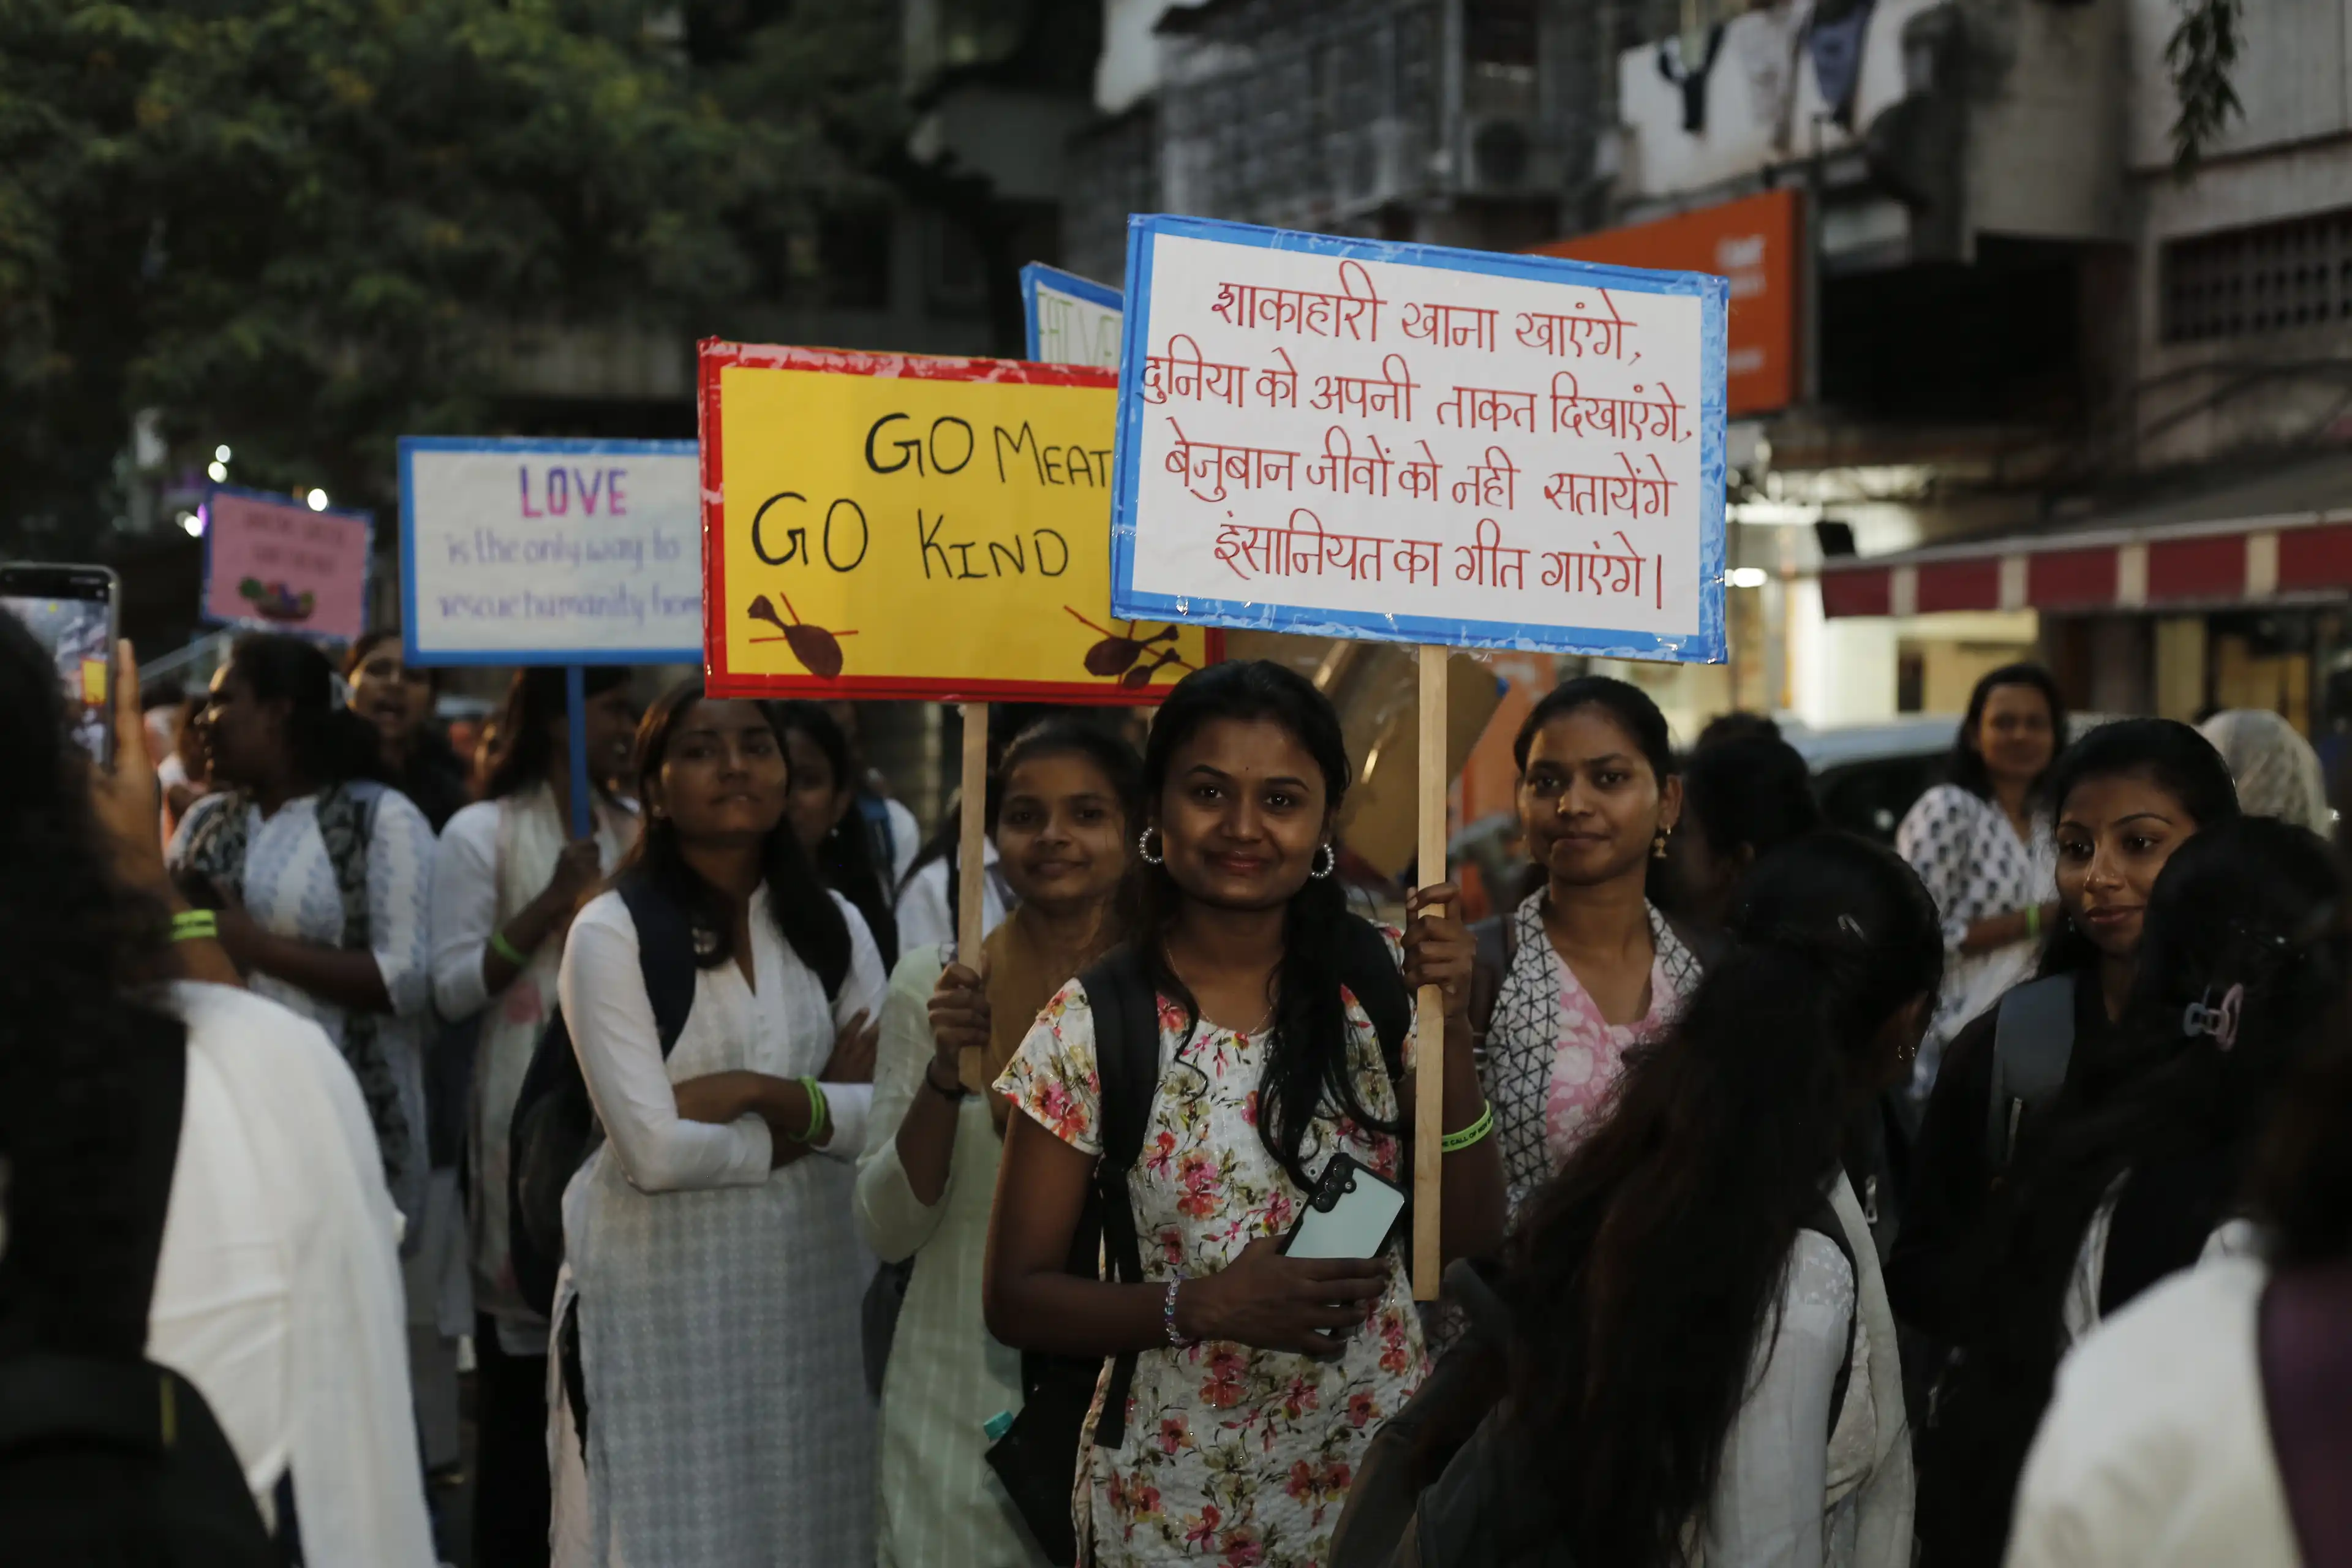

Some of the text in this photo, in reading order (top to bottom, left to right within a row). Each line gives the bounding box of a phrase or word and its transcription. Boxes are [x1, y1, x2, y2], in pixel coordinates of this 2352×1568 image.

[1212, 260, 1641, 366] शाकाहारी खाना खाएंगे,
[1136, 334, 1692, 443] दुनिया को अपनी ताकत दिखाएंगे,
[518, 464, 628, 518] LOVE
[865, 412, 1112, 488] GO MEAT
[1165, 417, 1678, 519] बेजुबान जीवों को नही सतायेंगे
[752, 492, 1069, 579] GO KIND
[1214, 508, 1395, 582] इंसानियत
[1393, 539, 1443, 587] का
[1455, 518, 1531, 590] गीत
[1450, 1136, 1469, 1145] CALL
